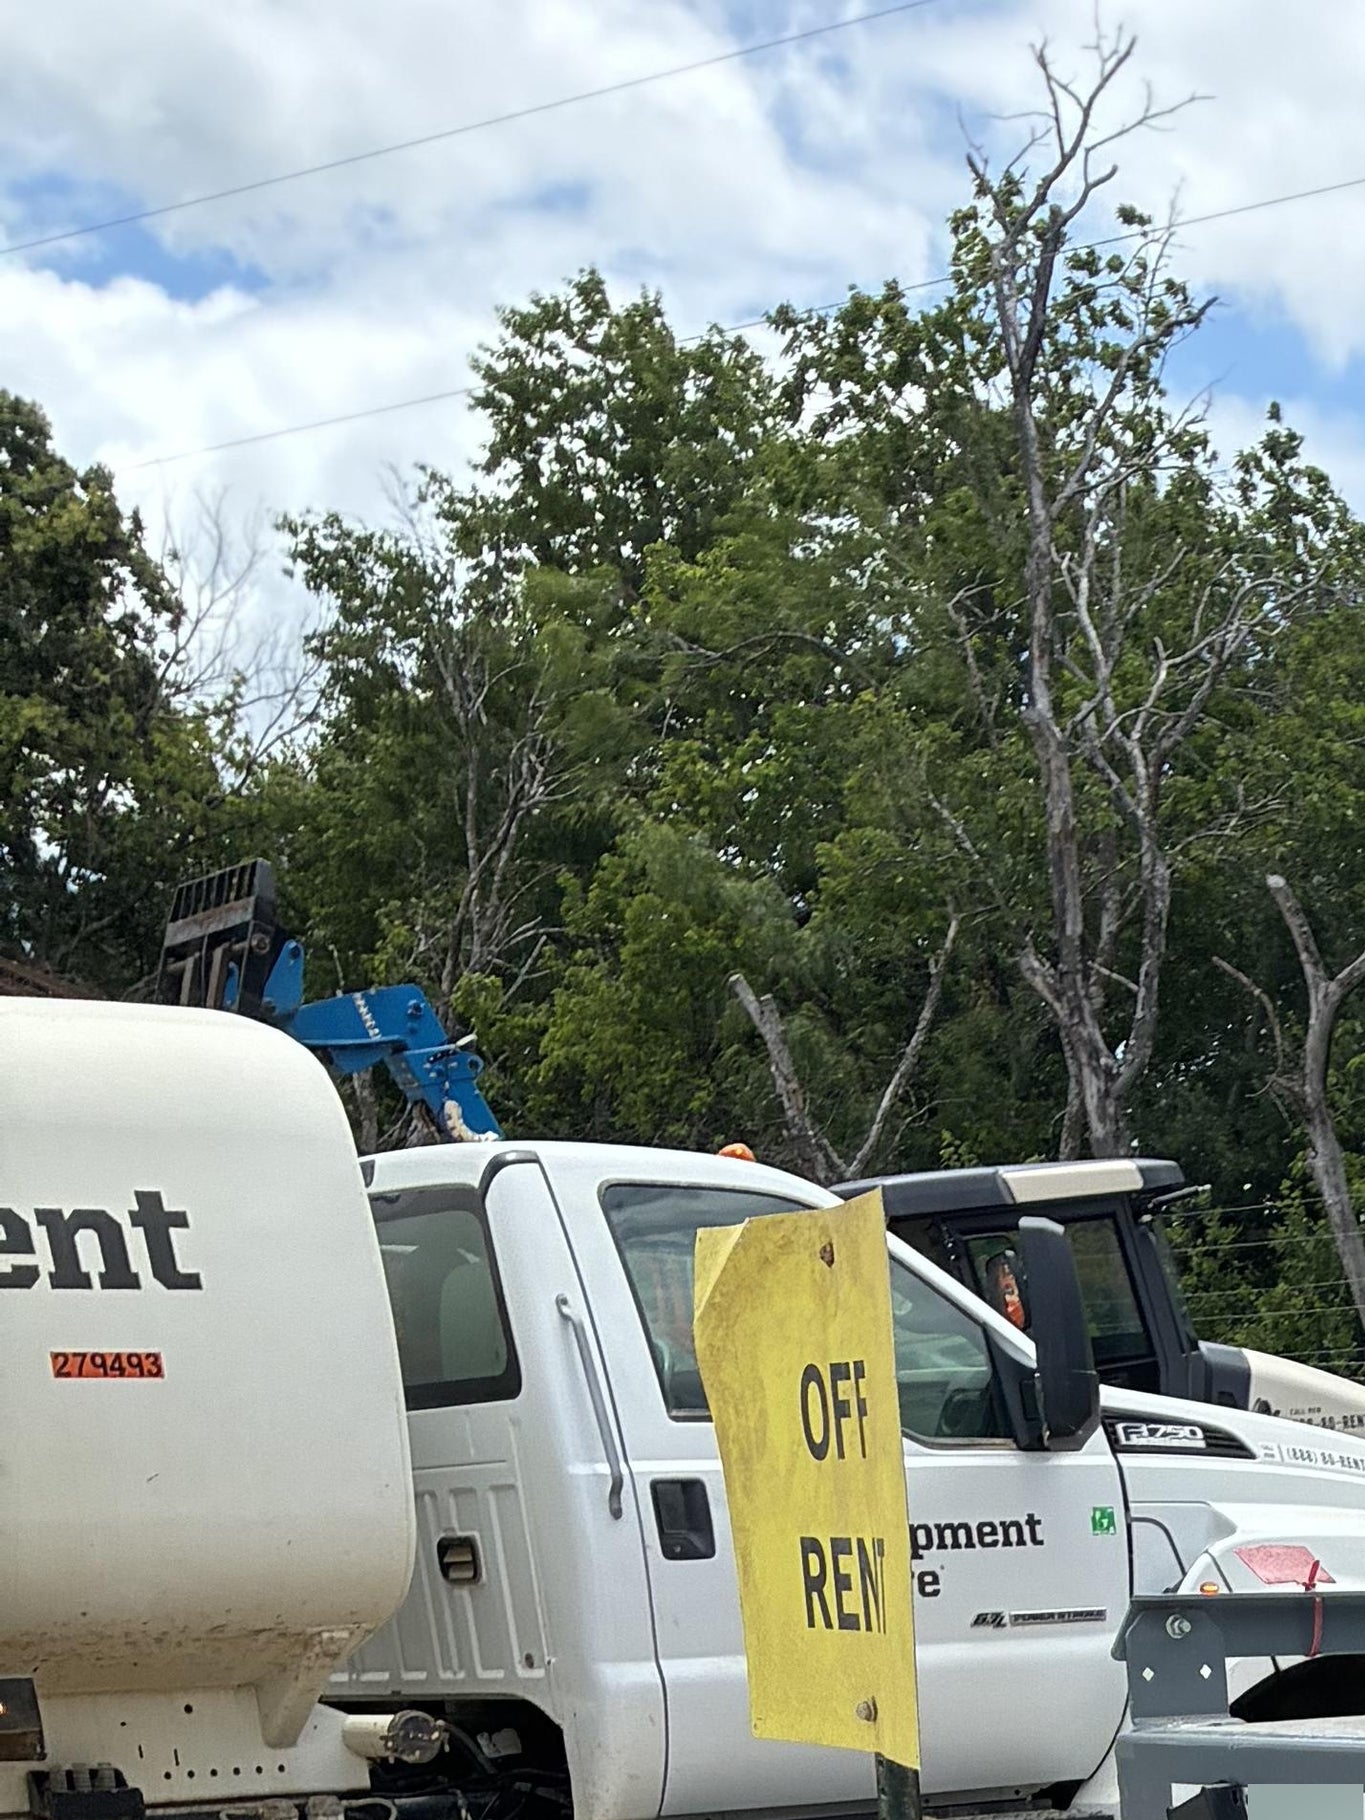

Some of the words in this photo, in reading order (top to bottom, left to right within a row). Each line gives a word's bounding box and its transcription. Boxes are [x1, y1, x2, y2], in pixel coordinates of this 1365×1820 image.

[54, 1352, 162, 1377] 279493
[801, 1360, 868, 1462] OFF
[909, 1513, 1044, 1560] pment
[801, 1536, 887, 1635] RENT
